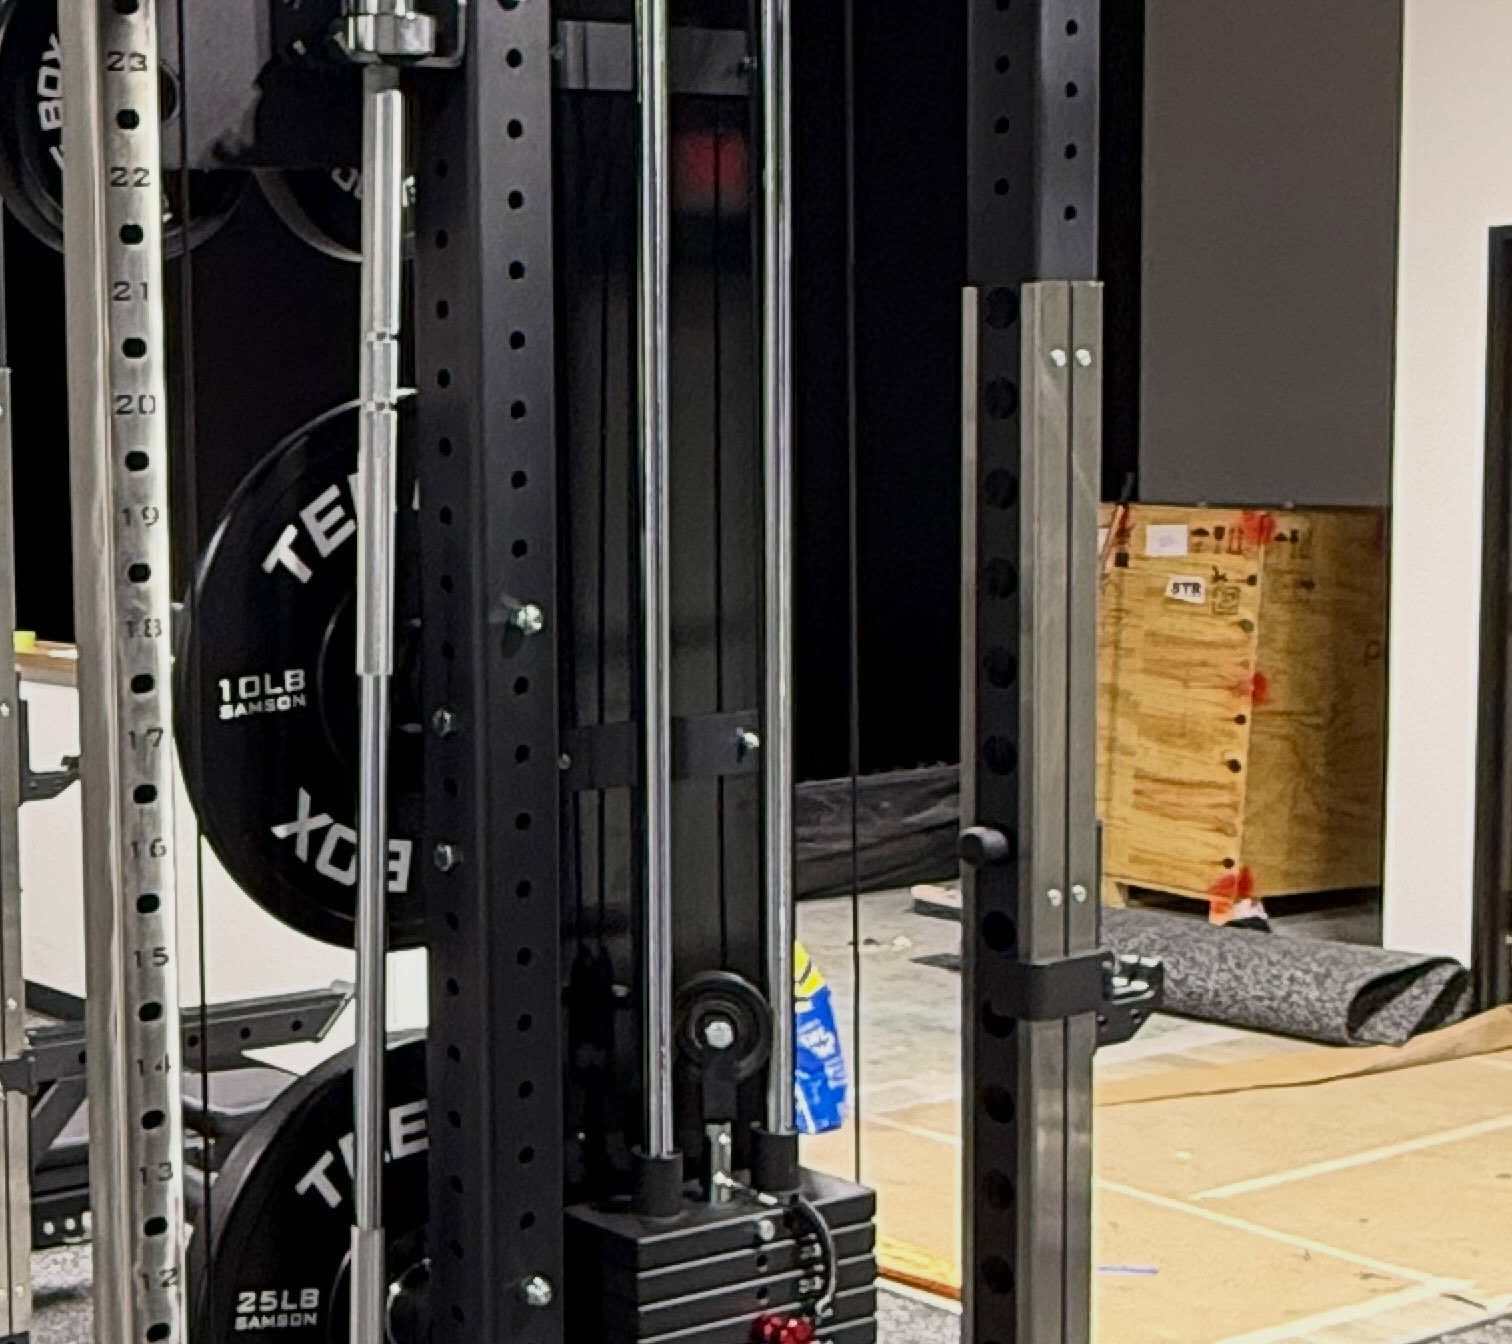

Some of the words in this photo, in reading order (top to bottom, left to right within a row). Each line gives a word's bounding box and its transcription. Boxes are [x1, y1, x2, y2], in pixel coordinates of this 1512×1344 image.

[106, 51, 148, 72] 23
[110, 166, 151, 187] 22
[112, 280, 149, 302] 21
[114, 394, 157, 416] 20
[121, 506, 159, 527] 19
[261, 473, 359, 584] TE
[126, 617, 162, 638] 18
[218, 668, 306, 702] 10LB
[219, 693, 306, 720] SAMSON
[128, 727, 164, 749] 17
[131, 837, 167, 859] 16
[134, 946, 170, 968] 15
[139, 1161, 174, 1185] 13
[141, 1267, 178, 1291] 12
[236, 1287, 319, 1314] 25LB
[235, 1312, 318, 1330] SAMSON
